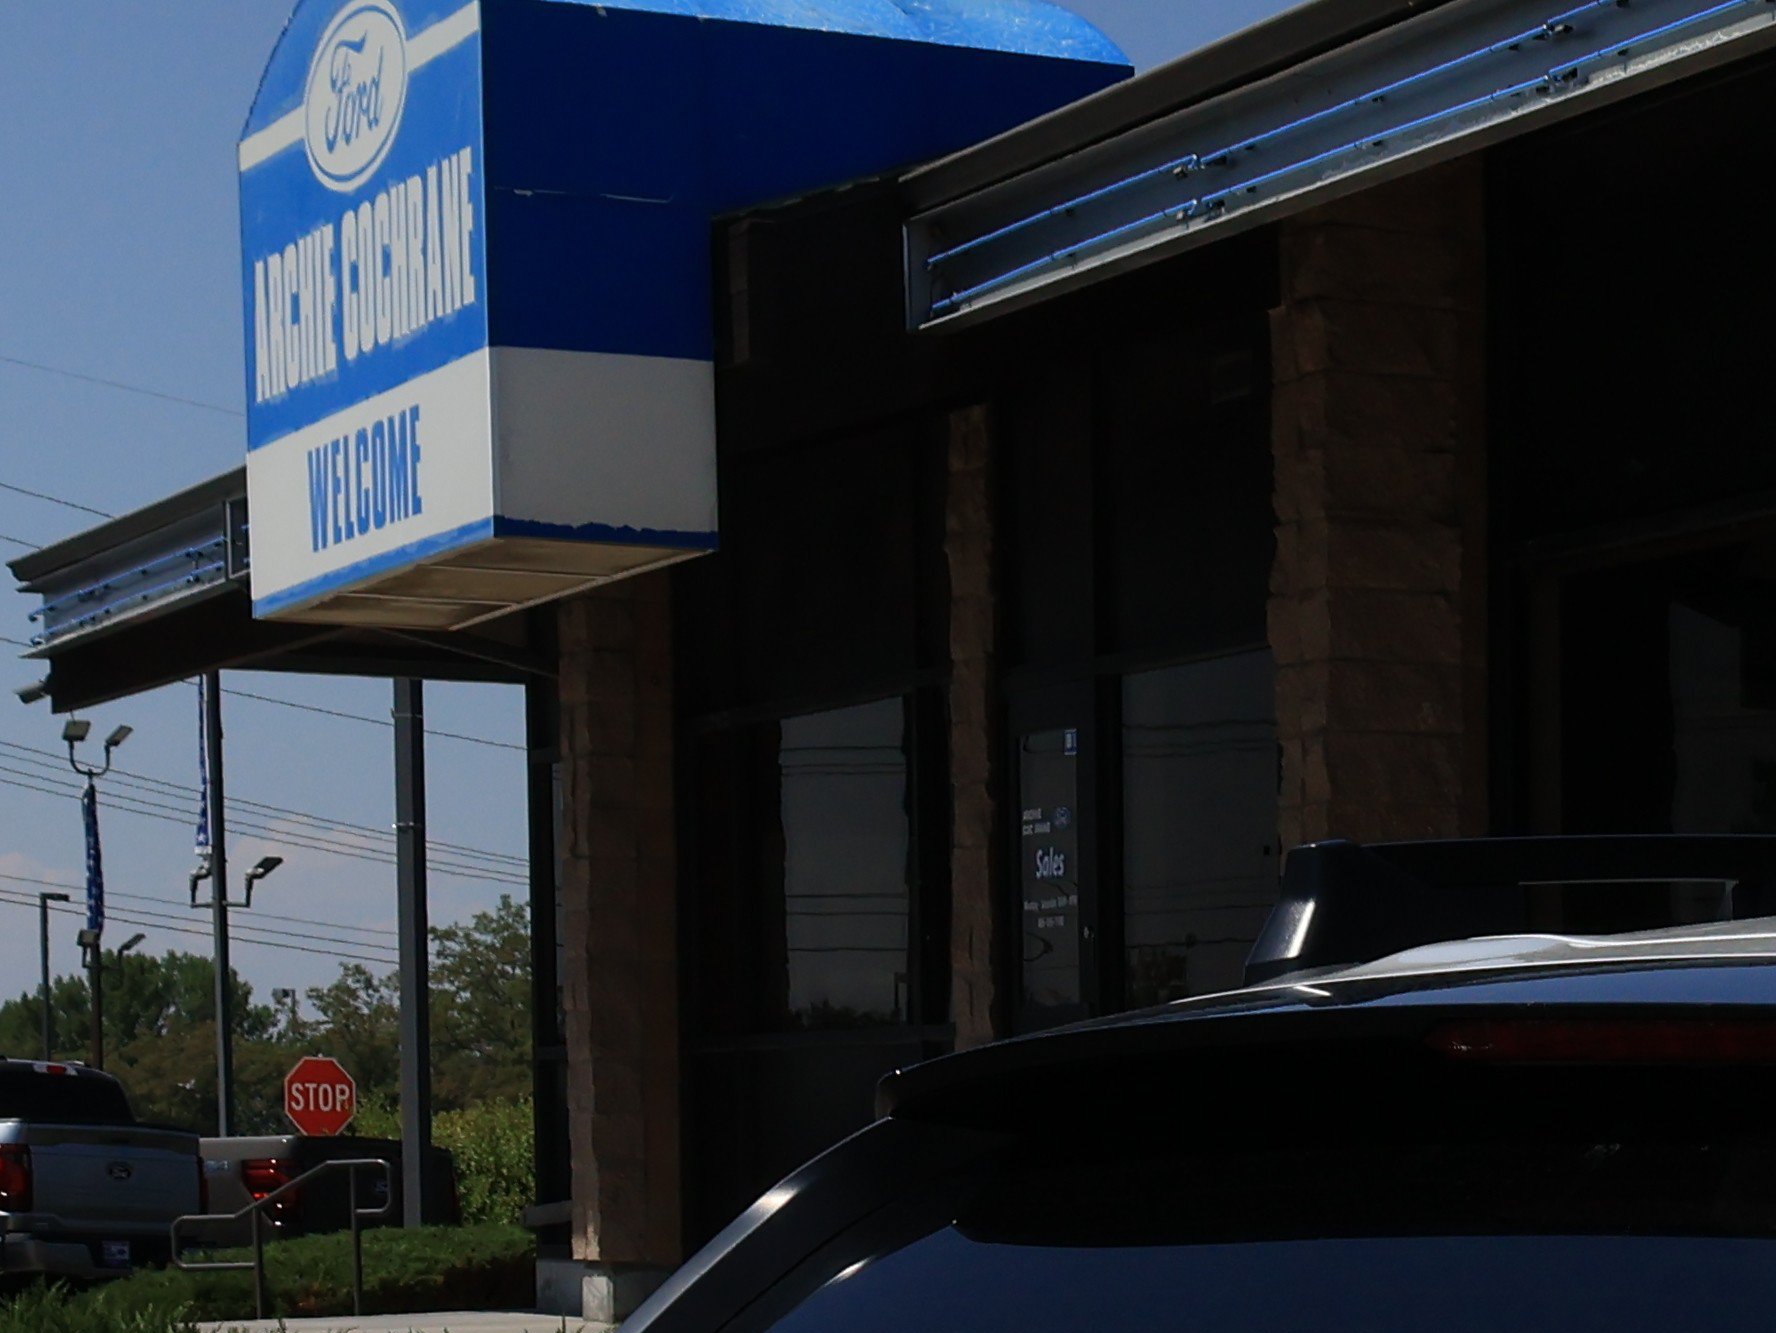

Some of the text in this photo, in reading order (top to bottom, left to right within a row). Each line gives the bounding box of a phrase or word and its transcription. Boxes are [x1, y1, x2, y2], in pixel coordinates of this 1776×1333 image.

[323, 31, 383, 154] Ford
[254, 146, 476, 404] ARCHIE COCHRANE
[307, 404, 422, 553] WELCOME
[1034, 847, 1066, 879] Sales
[290, 1083, 350, 1112] STOP
